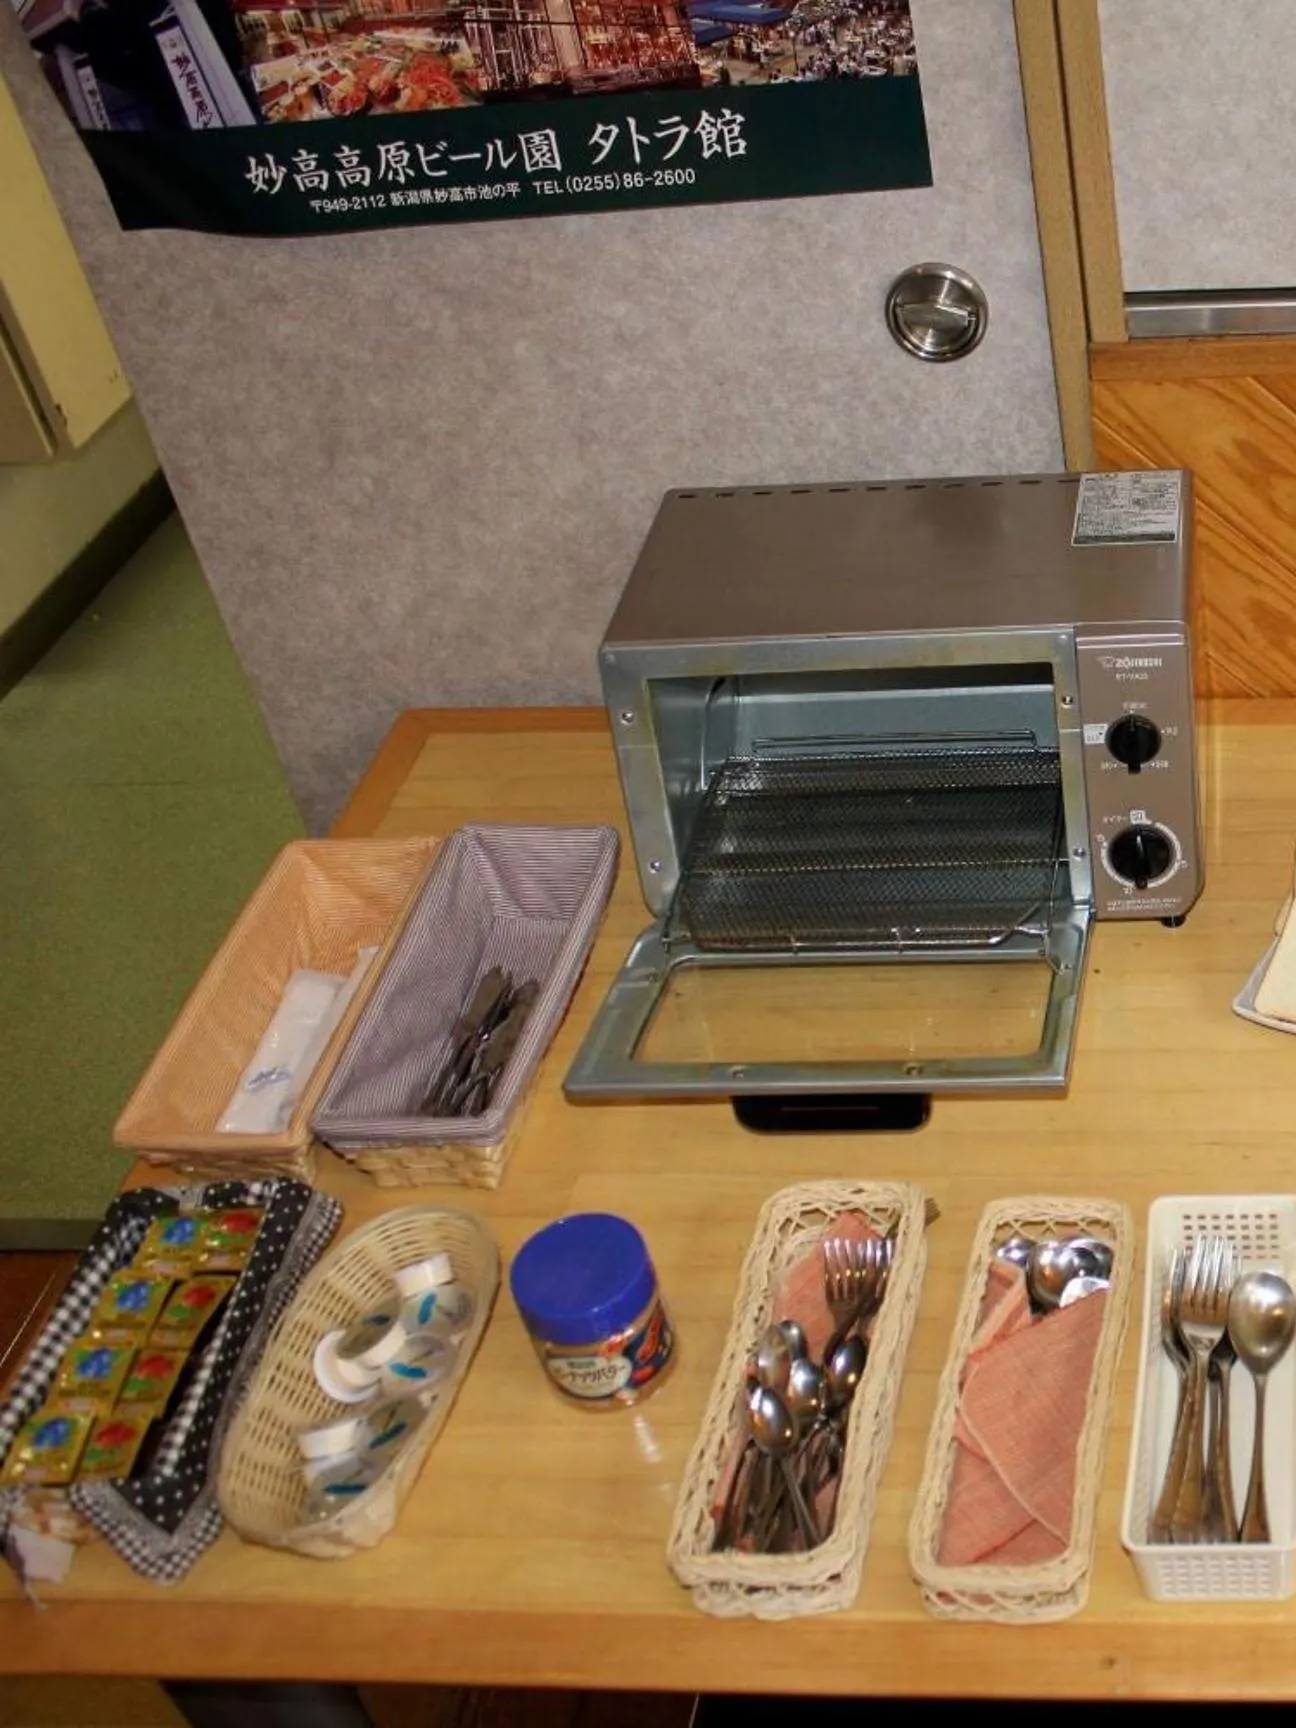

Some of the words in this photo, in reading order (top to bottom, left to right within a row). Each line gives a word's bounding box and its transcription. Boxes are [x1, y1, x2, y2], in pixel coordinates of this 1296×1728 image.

[245, 128, 562, 194] 妙高高原ビール園
[588, 107, 748, 166] タトラ館
[390, 182, 521, 208] 新潟県妙高市池の平
